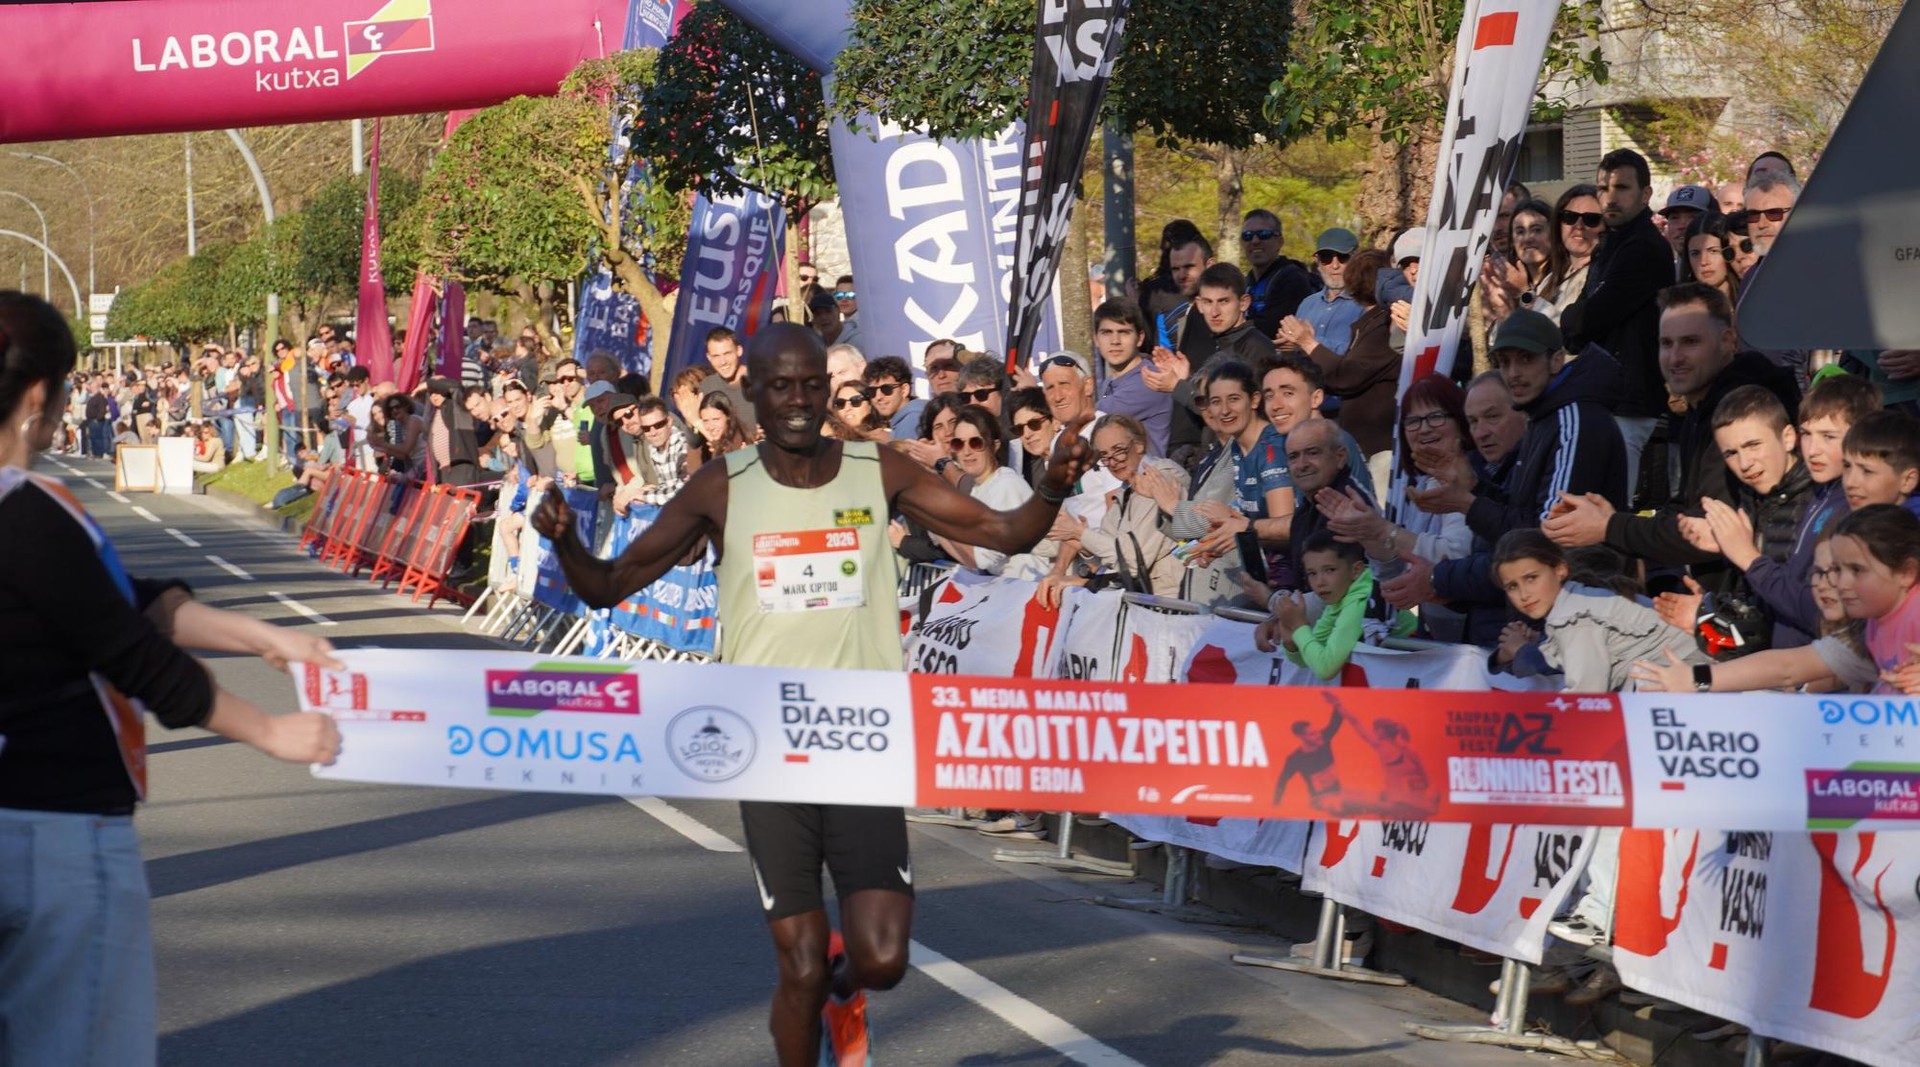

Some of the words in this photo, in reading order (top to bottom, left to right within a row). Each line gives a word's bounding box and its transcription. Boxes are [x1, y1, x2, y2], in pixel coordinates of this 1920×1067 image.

[132, 25, 338, 72] LABORAL
[256, 67, 339, 92] kutxa
[825, 532, 855, 547] 2026
[803, 564, 814, 577] 4
[783, 582, 806, 595] MARK
[810, 581, 838, 593] KIPTOO
[492, 680, 601, 696] LABORAL
[780, 682, 815, 701] EL
[932, 686, 966, 708] 33.
[970, 688, 1029, 709] MEDIA
[1035, 689, 1128, 712] MARATÓN
[556, 697, 605, 708] kutxa
[1818, 700, 1920, 727] DOM
[782, 705, 890, 727] DIARIO
[1650, 708, 1686, 727] EL
[447, 725, 643, 763] DOMUSA
[679, 740, 744, 758] LOIOLA
[785, 729, 889, 752] VASCO
[935, 712, 1269, 767] AZKOITIAZPEITIA
[1655, 731, 1760, 753] DIARIO
[696, 759, 728, 767] HOTEL
[1659, 756, 1760, 779] VASCO
[446, 765, 644, 788] TEKNIK
[935, 763, 1023, 791] MARATOI
[1030, 766, 1084, 793] ERDIA
[1448, 757, 1551, 793] RUNNING
[1553, 759, 1624, 795] FESTA
[1812, 778, 1918, 798] LABORAL
[1874, 799, 1919, 812] kutxa
